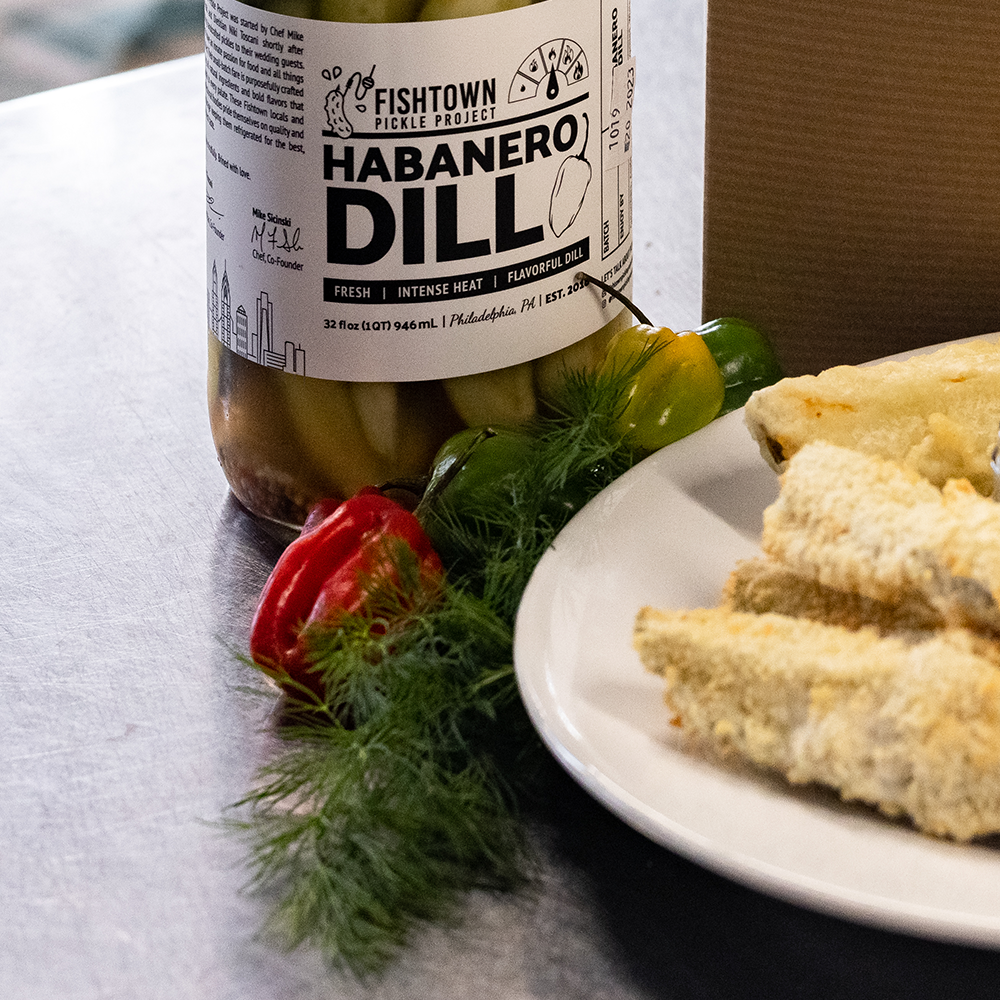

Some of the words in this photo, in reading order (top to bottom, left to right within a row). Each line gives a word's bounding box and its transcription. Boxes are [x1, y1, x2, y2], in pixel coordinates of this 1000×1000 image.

[240, 18, 258, 32] started
[260, 24, 268, 36] by
[270, 26, 284, 38] Chef
[287, 30, 304, 42] Mike
[240, 30, 259, 45] Toscani
[262, 39, 284, 54] shortly
[288, 44, 304, 56] after
[241, 44, 253, 57] their
[254, 50, 280, 67] wedding
[281, 58, 304, 70] guests.
[240, 72, 246, 81] is
[246, 75, 280, 94] purposefully
[280, 85, 304, 97] crafted
[246, 60, 259, 74] food
[260, 66, 272, 77] and
[272, 69, 281, 79] all
[282, 71, 304, 84] things
[240, 87, 250, 98] and
[252, 89, 264, 102] bold
[266, 94, 288, 108] flavors
[290, 100, 304, 112] that
[375, 78, 496, 115] FISHTOWN
[626, 67, 634, 110] 2023
[229, 92, 242, 108] These
[244, 100, 268, 117] Fishtown
[270, 108, 288, 122] locals
[290, 116, 304, 126] and
[375, 116, 426, 130] PICKLE
[435, 106, 496, 127] PROJECT
[233, 110, 260, 129] themselves
[260, 122, 268, 131] on
[268, 124, 290, 138] quality
[290, 130, 304, 140] and
[234, 124, 262, 143] refrigerated
[264, 135, 274, 146] for
[275, 139, 286, 150] the
[608, 108, 620, 150] 1019
[323, 114, 579, 183] HABANERO
[252, 207, 266, 220] Mike
[326, 173, 545, 266] DILL
[252, 248, 267, 264] Chef,
[267, 254, 304, 272] Co-Founder
[334, 285, 371, 298] FRESH
[398, 283, 449, 298] INTENSE
[454, 278, 484, 294] HEAT
[508, 256, 563, 284] FLAVORFUL
[565, 247, 584, 265] DILL
[324, 320, 337, 329] 32
[394, 320, 417, 331] 946
[418, 318, 438, 329] mL
[520, 296, 536, 313] PA
[545, 288, 566, 304] EST.
